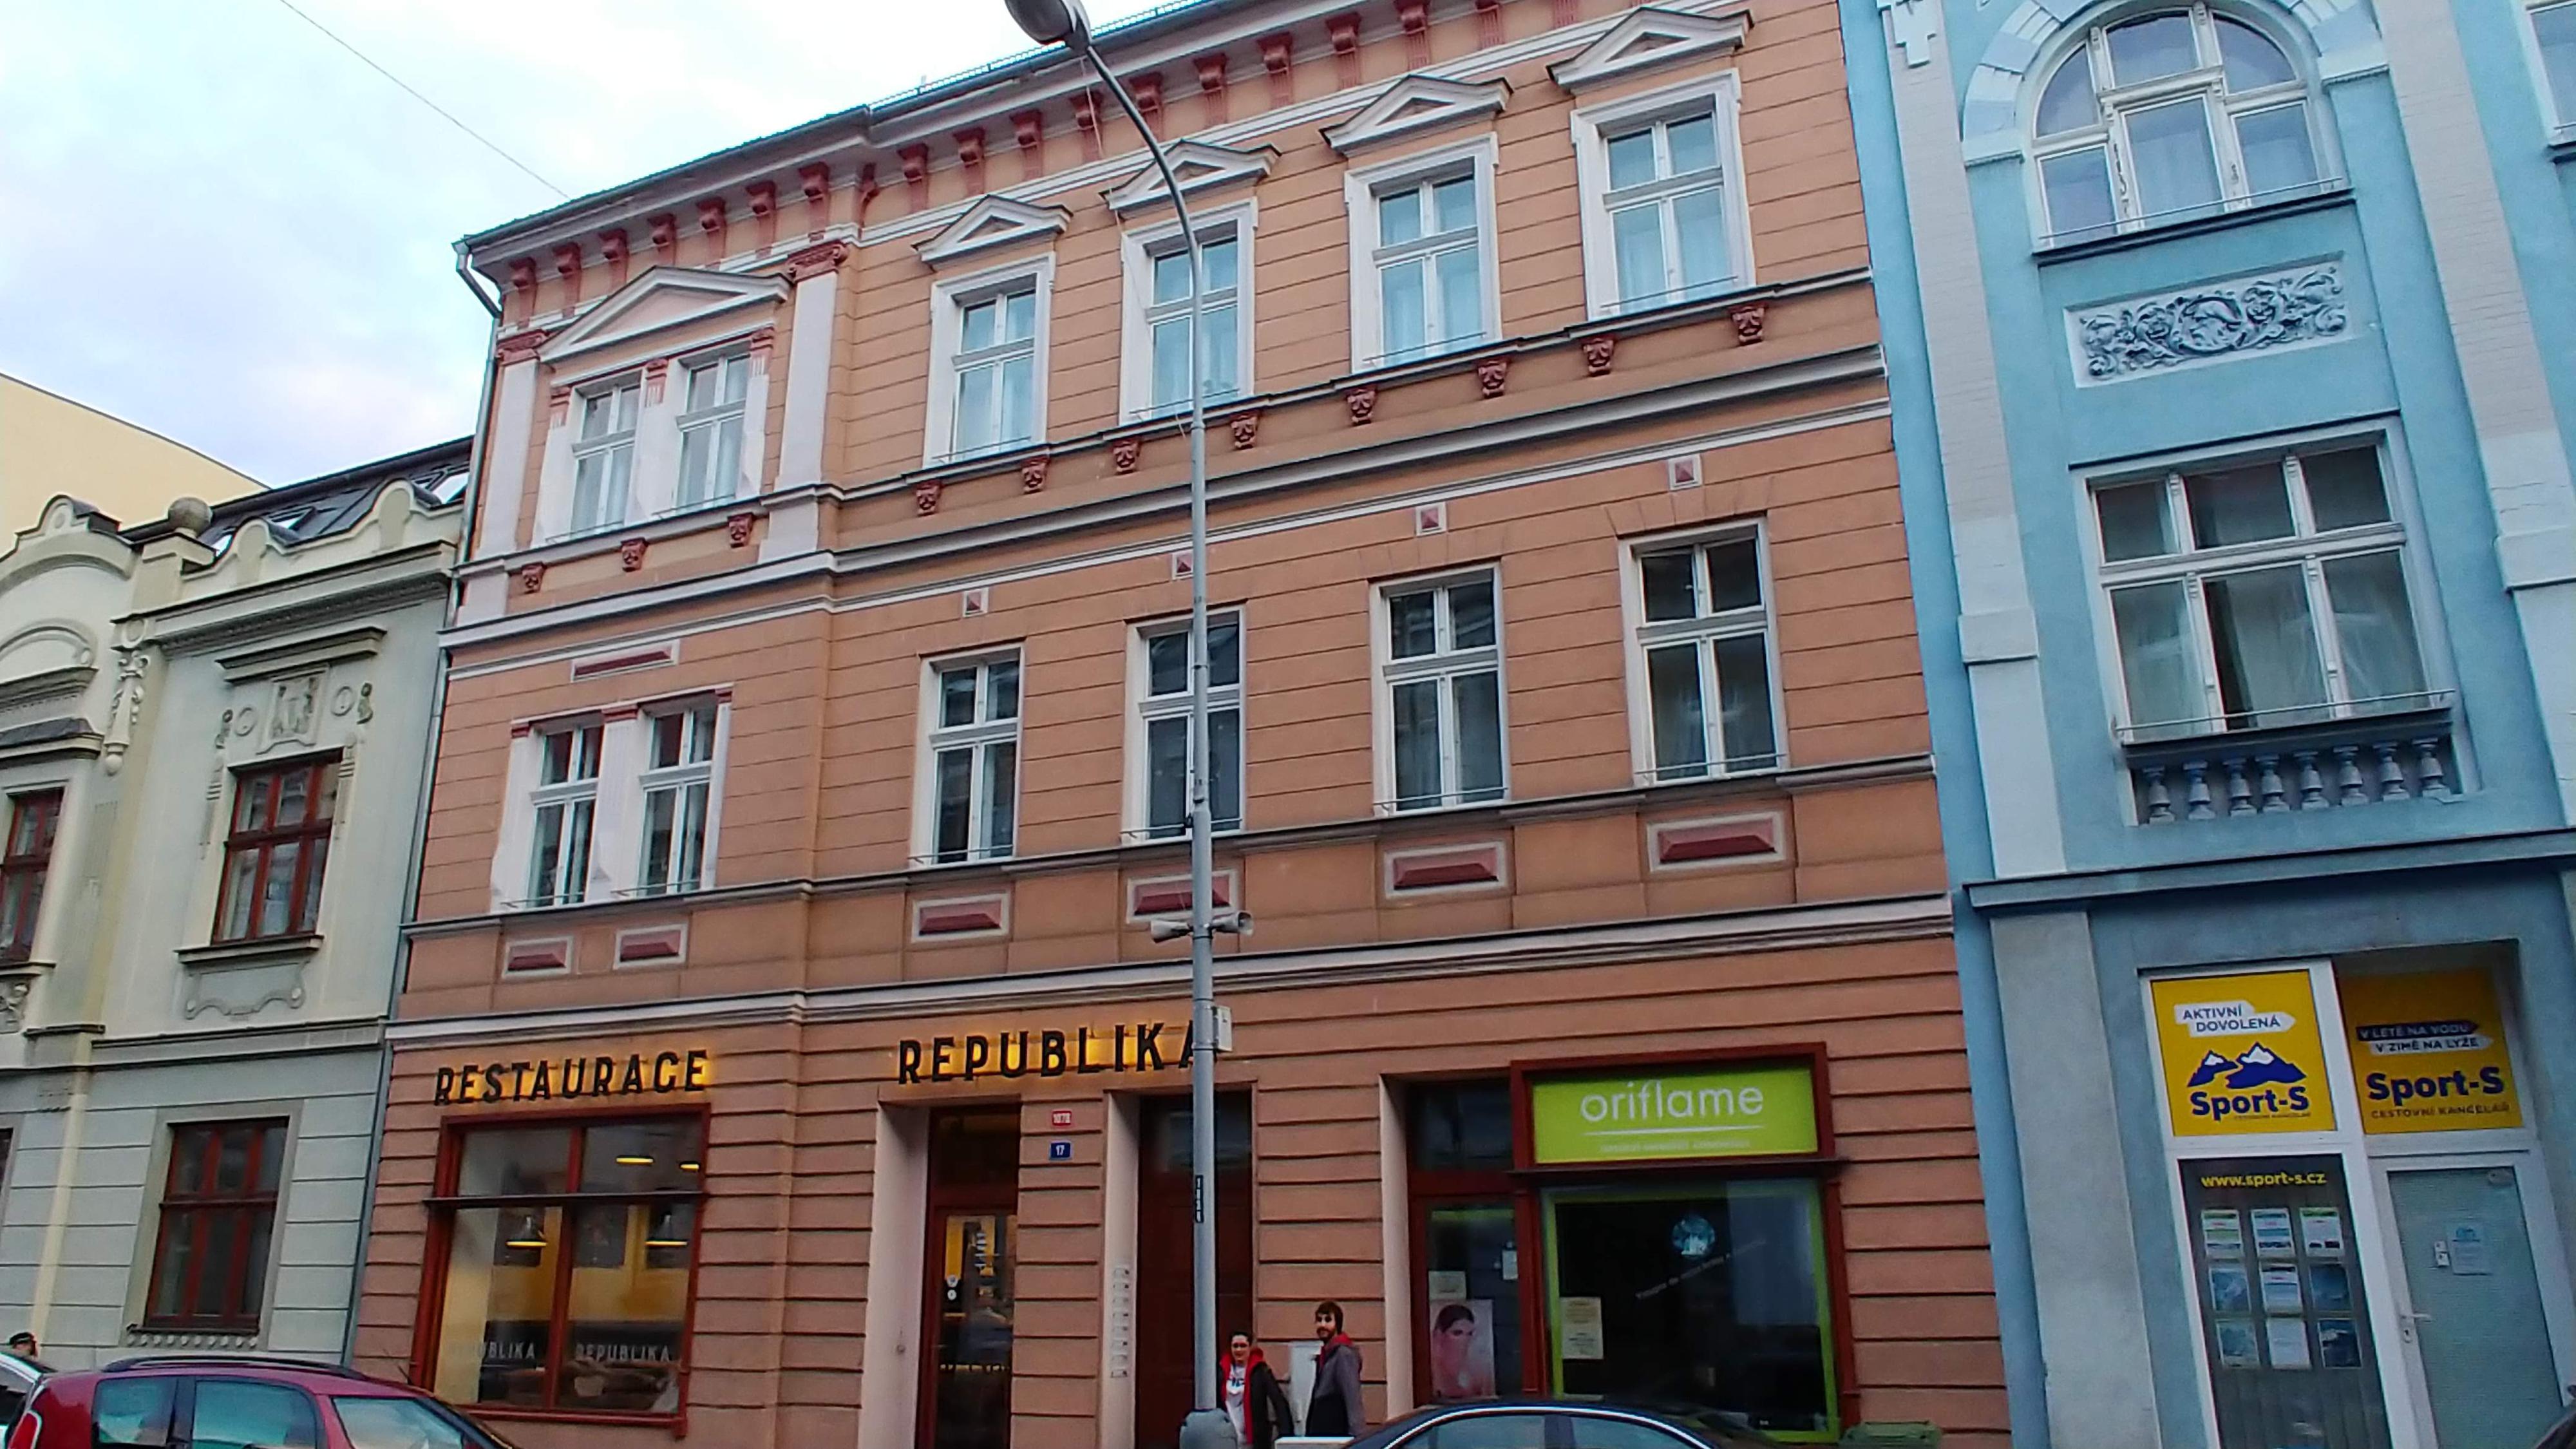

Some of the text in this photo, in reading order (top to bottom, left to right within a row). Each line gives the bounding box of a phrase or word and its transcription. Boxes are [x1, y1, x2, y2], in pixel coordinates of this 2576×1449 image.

[2183, 1004, 2242, 1020] AKTIVNÍ
[2196, 1014, 2281, 1032] DOVOLENÁ
[2375, 1043, 2384, 1053] V
[2423, 1038, 2443, 1049] NA
[434, 1050, 707, 1106] RESTAURACE
[2366, 1066, 2505, 1106] Sport-S
[1580, 1079, 1764, 1122] oriflame
[2190, 1086, 2309, 1121] Sport-S
[1056, 1144, 1065, 1156] 17
[2201, 1172, 2327, 1188] www.sport-s.cz
